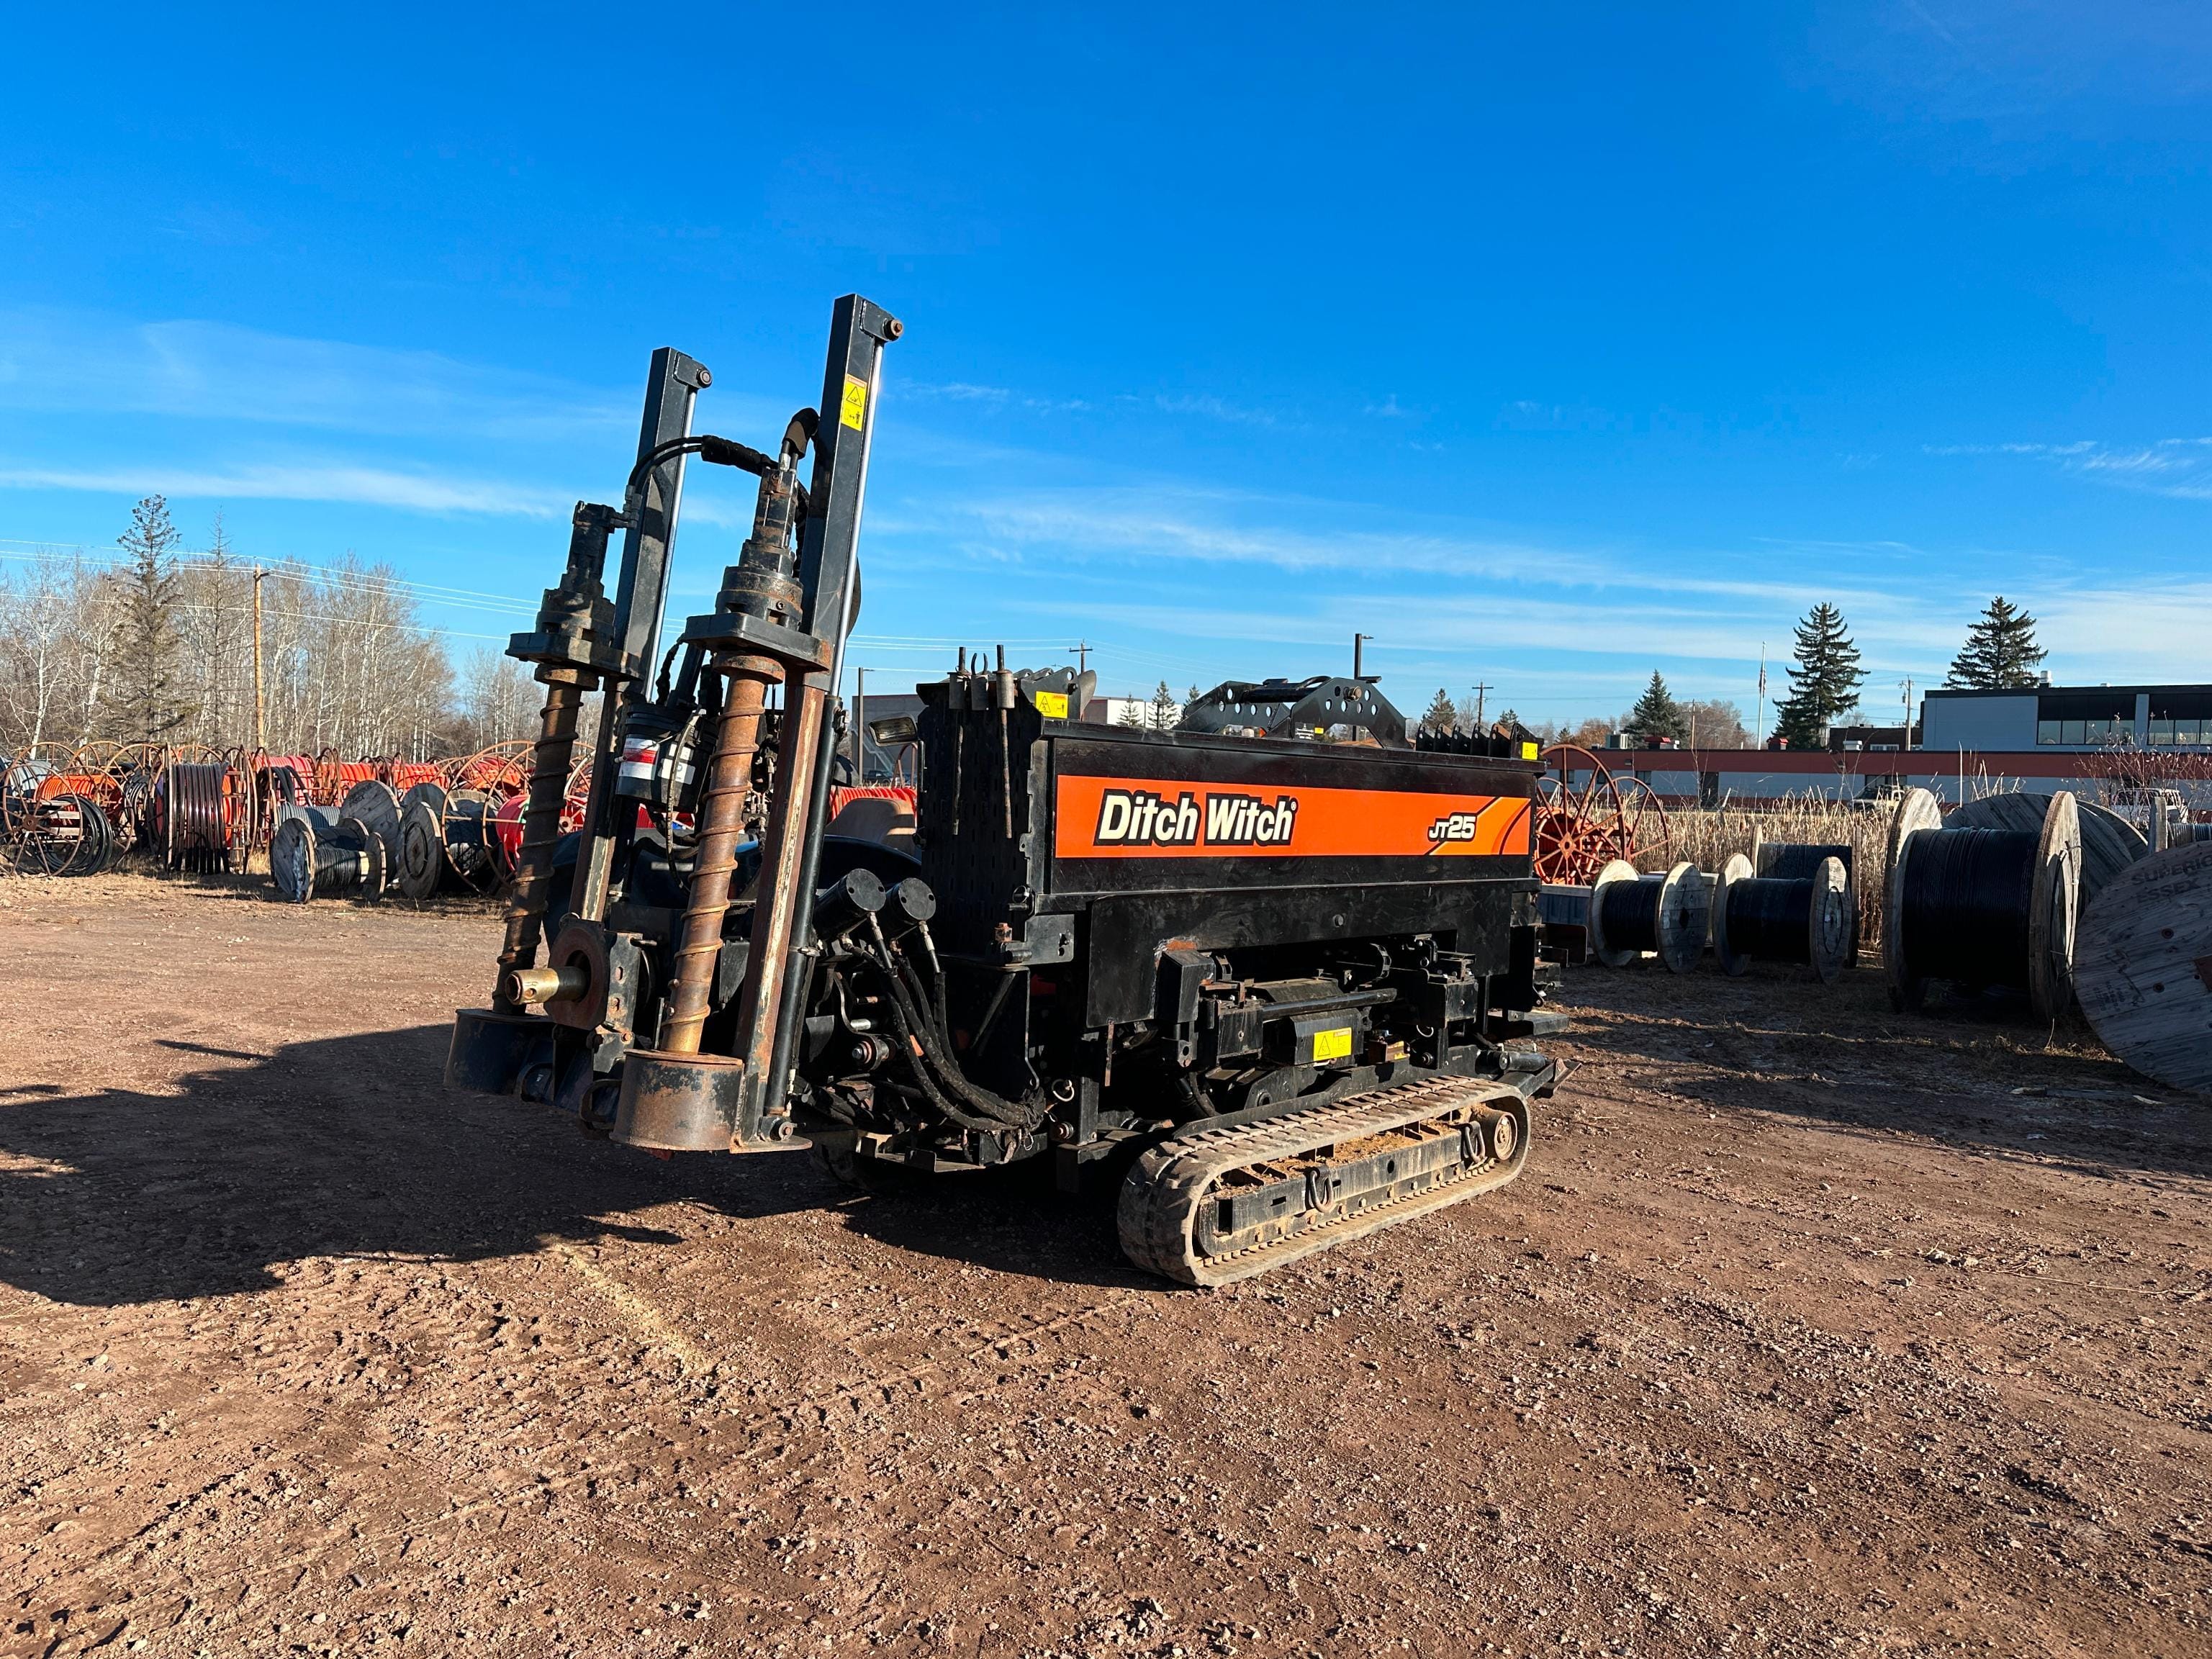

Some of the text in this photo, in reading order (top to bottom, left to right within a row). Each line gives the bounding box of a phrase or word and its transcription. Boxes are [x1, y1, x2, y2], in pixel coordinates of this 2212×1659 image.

[1098, 794, 1199, 841] Ditch
[1428, 815, 1476, 839] JT25
[2136, 878, 2201, 903] ESSEX
